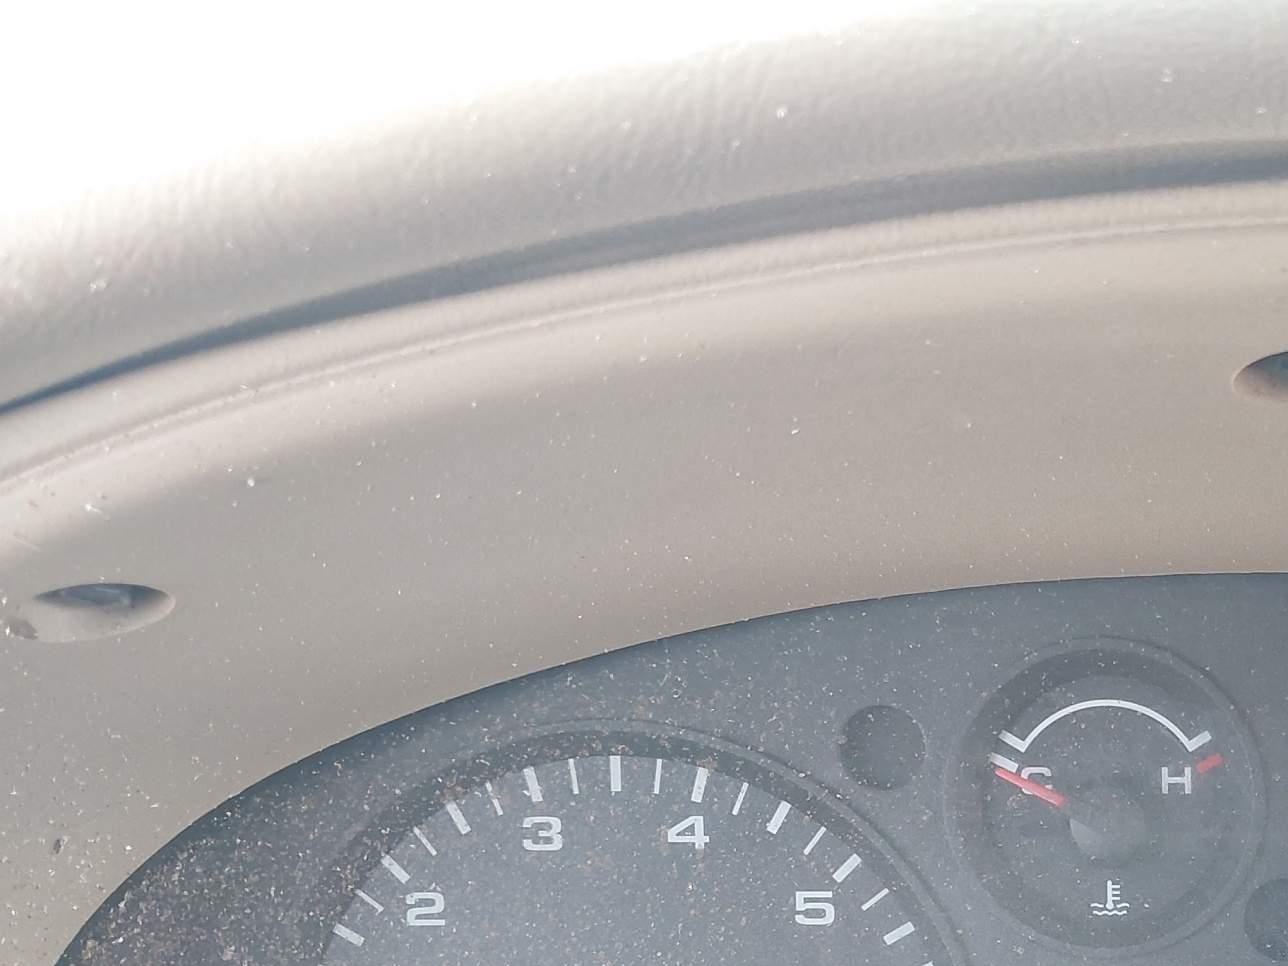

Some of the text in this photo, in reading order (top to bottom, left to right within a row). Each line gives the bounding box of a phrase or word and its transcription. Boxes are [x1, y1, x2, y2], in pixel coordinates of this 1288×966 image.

[1161, 766, 1192, 794] H
[522, 815, 564, 851] 3
[667, 815, 709, 849] 4
[406, 892, 446, 927] 2
[795, 891, 836, 926] 5
